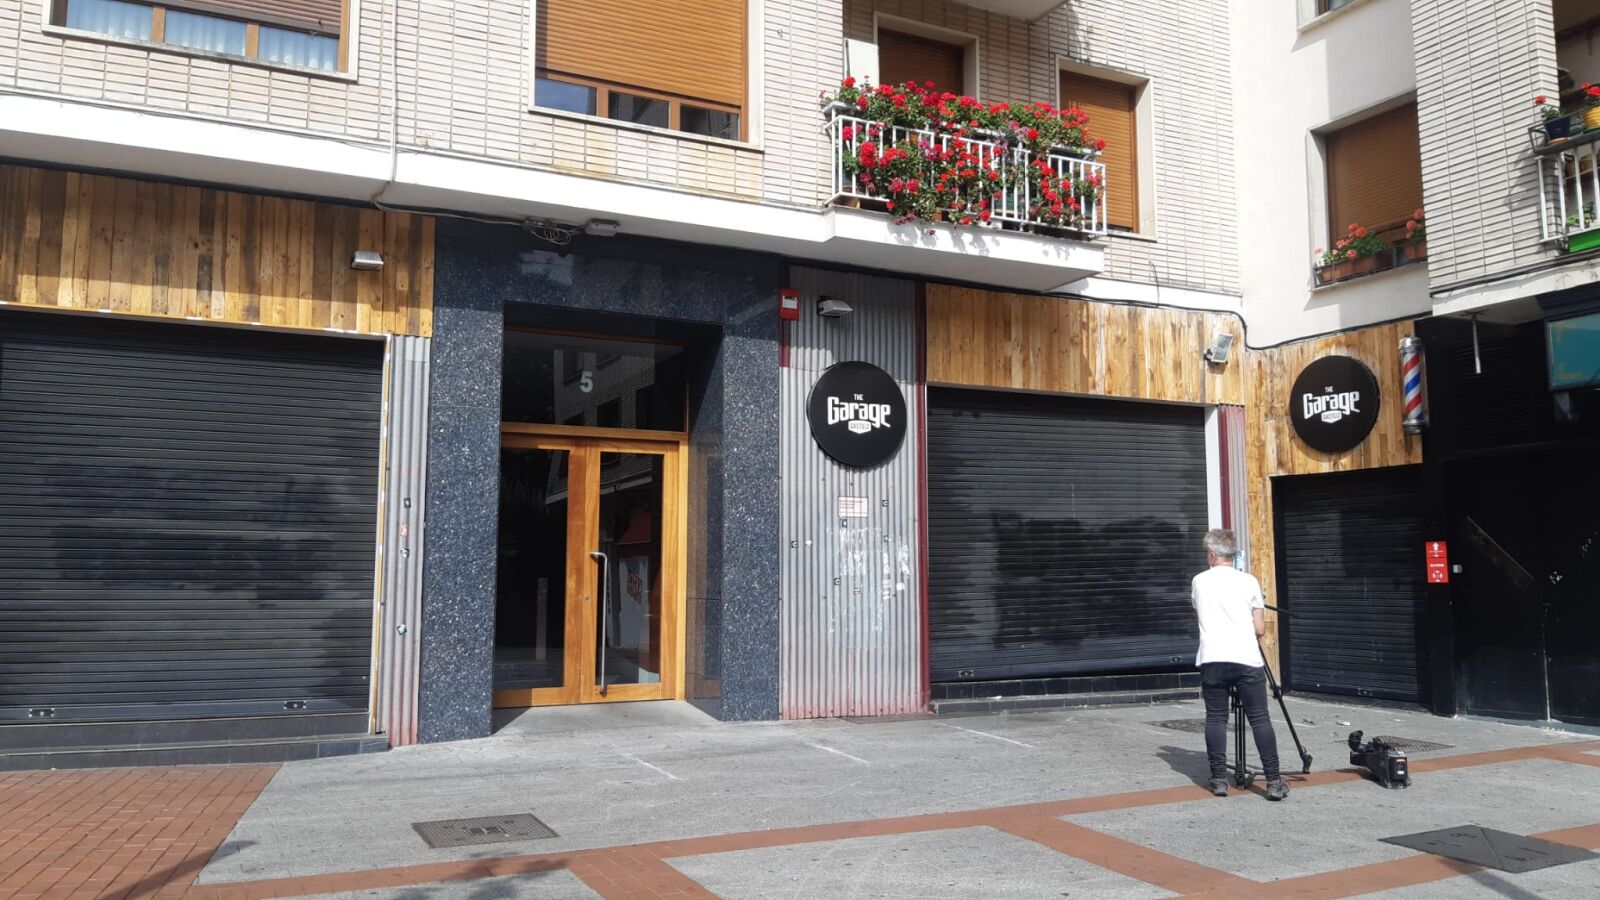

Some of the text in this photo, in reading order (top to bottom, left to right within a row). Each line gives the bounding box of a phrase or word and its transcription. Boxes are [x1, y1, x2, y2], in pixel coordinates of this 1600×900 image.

[580, 371, 593, 393] 5
[827, 396, 891, 428] Garage
[1303, 391, 1360, 420] Garage
